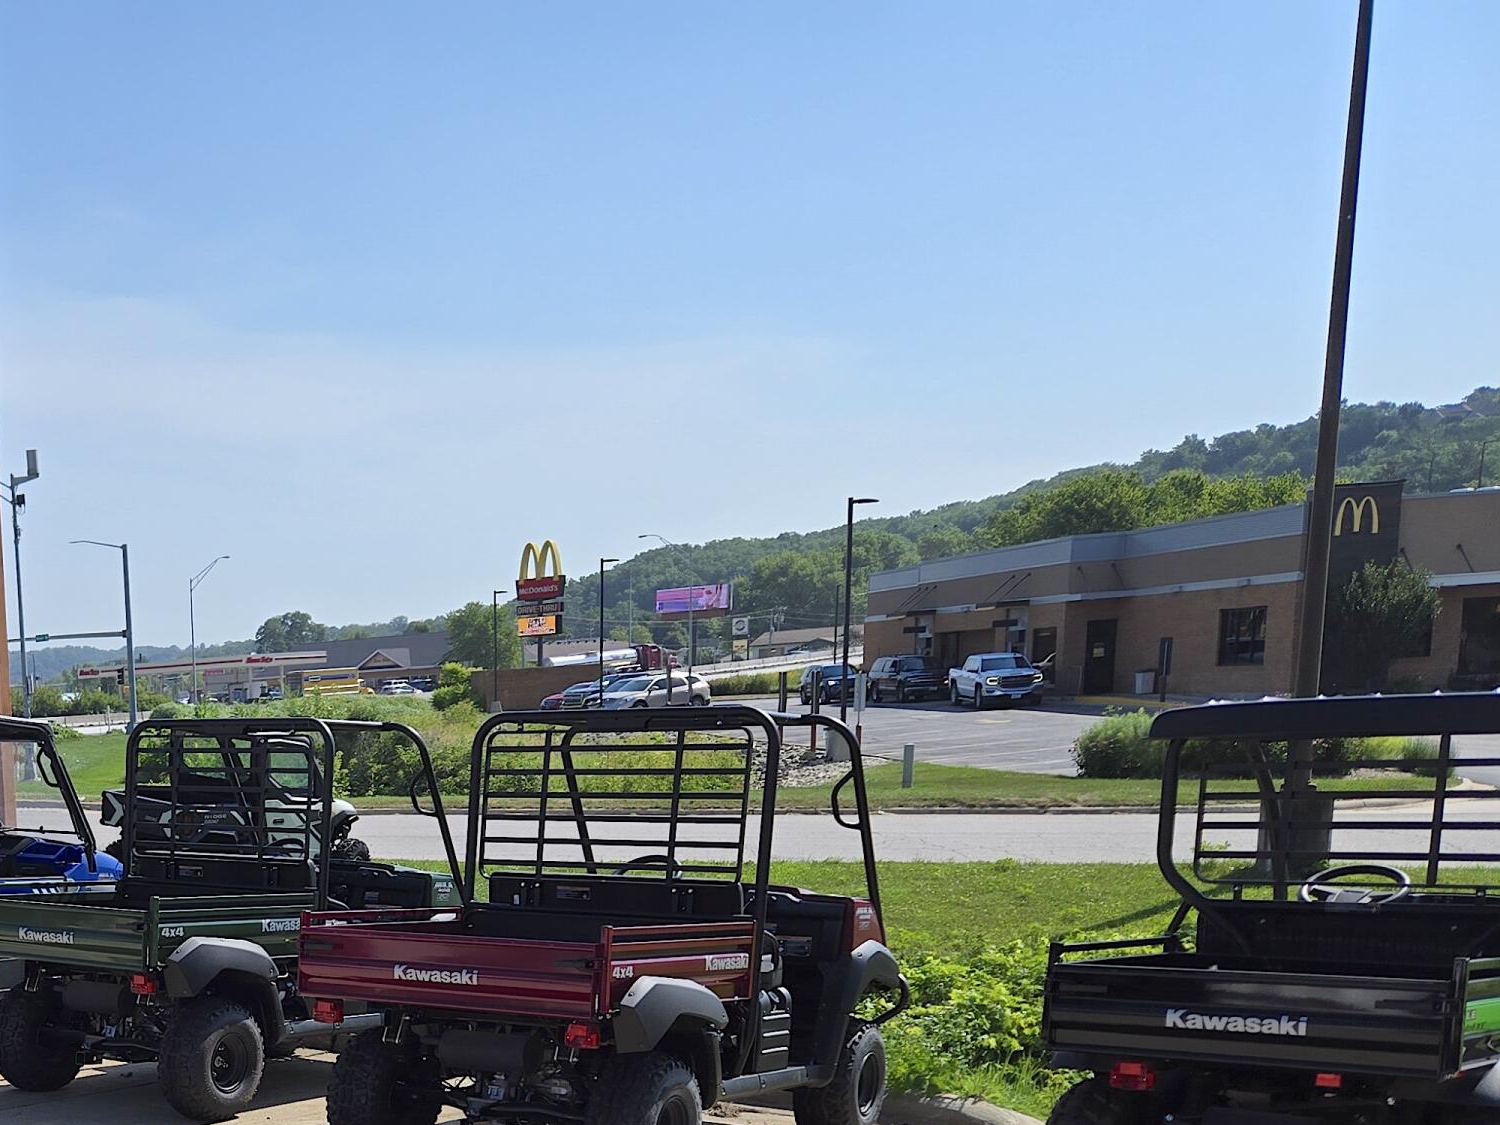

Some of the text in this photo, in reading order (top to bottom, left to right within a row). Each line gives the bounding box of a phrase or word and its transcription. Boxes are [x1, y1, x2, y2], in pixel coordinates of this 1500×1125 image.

[518, 584, 558, 595] McDonald's
[18, 927, 75, 945] Kawasaki
[161, 926, 185, 938] 4x4
[705, 955, 749, 971] Kawasaki
[393, 964, 478, 986] Kawasaki
[612, 966, 634, 979] 4x4
[1165, 1008, 1308, 1037] Kawasaki
